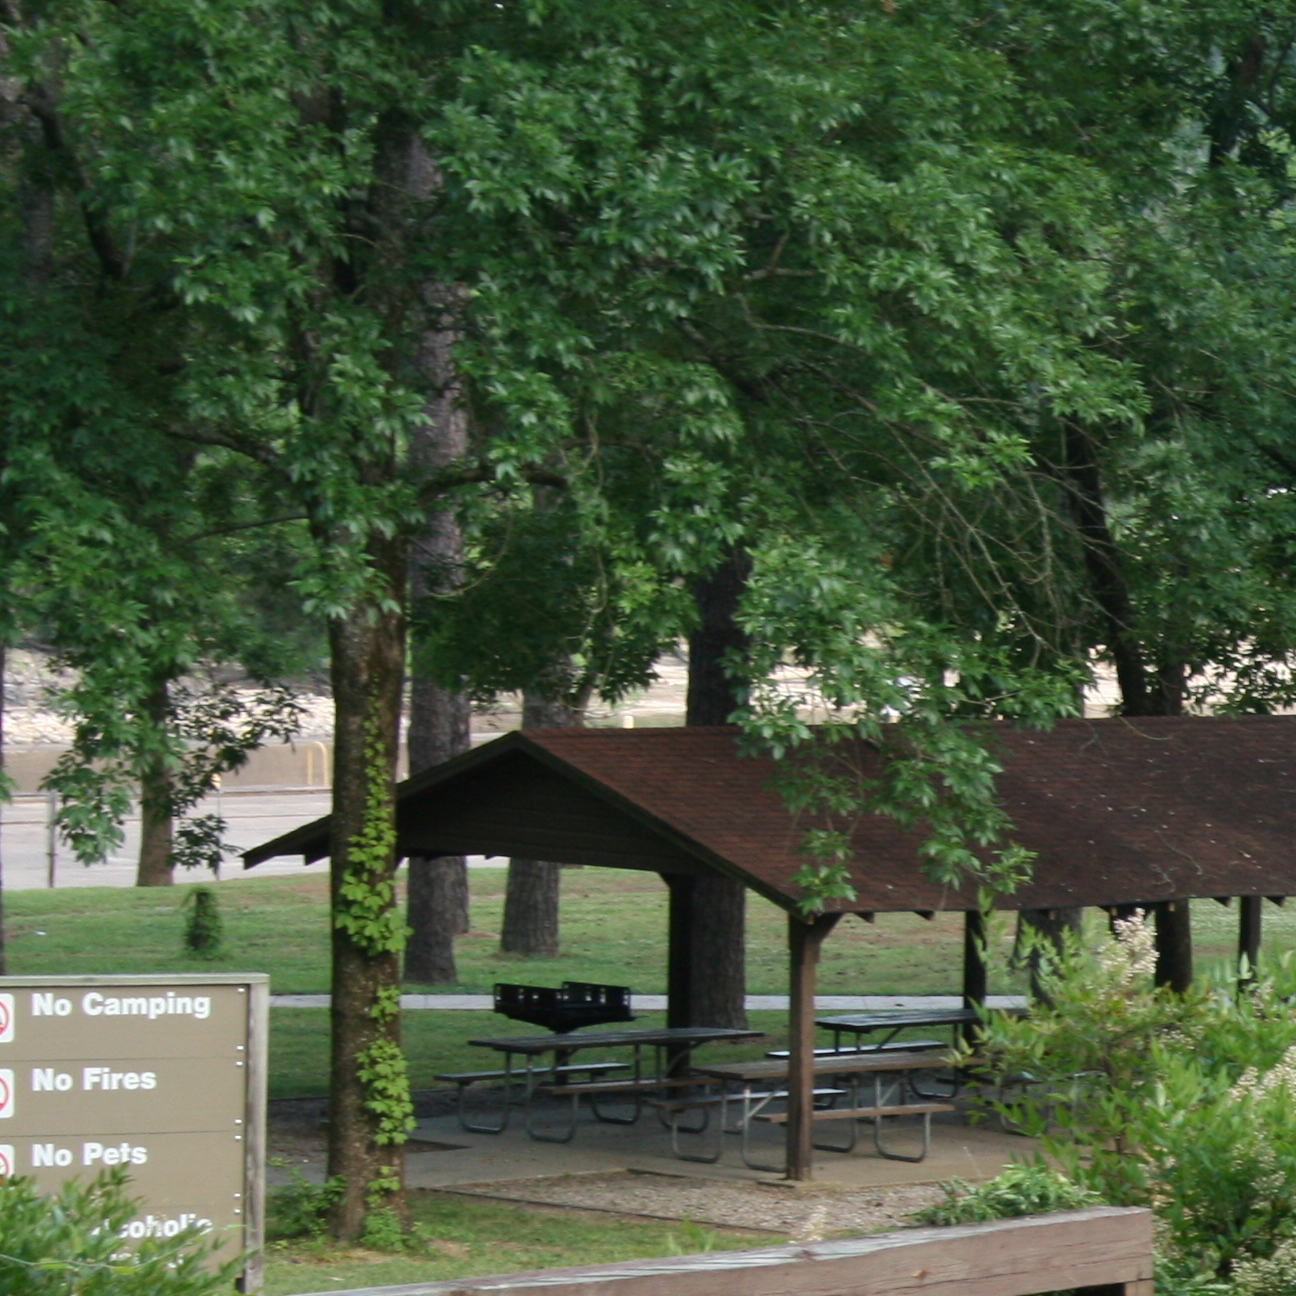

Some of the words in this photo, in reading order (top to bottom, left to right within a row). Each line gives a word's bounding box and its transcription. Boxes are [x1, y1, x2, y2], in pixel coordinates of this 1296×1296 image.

[32, 992, 72, 1016] No
[82, 991, 211, 1019] Camping
[32, 1067, 73, 1091] No
[82, 1066, 157, 1090] Fires
[32, 1142, 73, 1166] No
[82, 1141, 148, 1166] Pets
